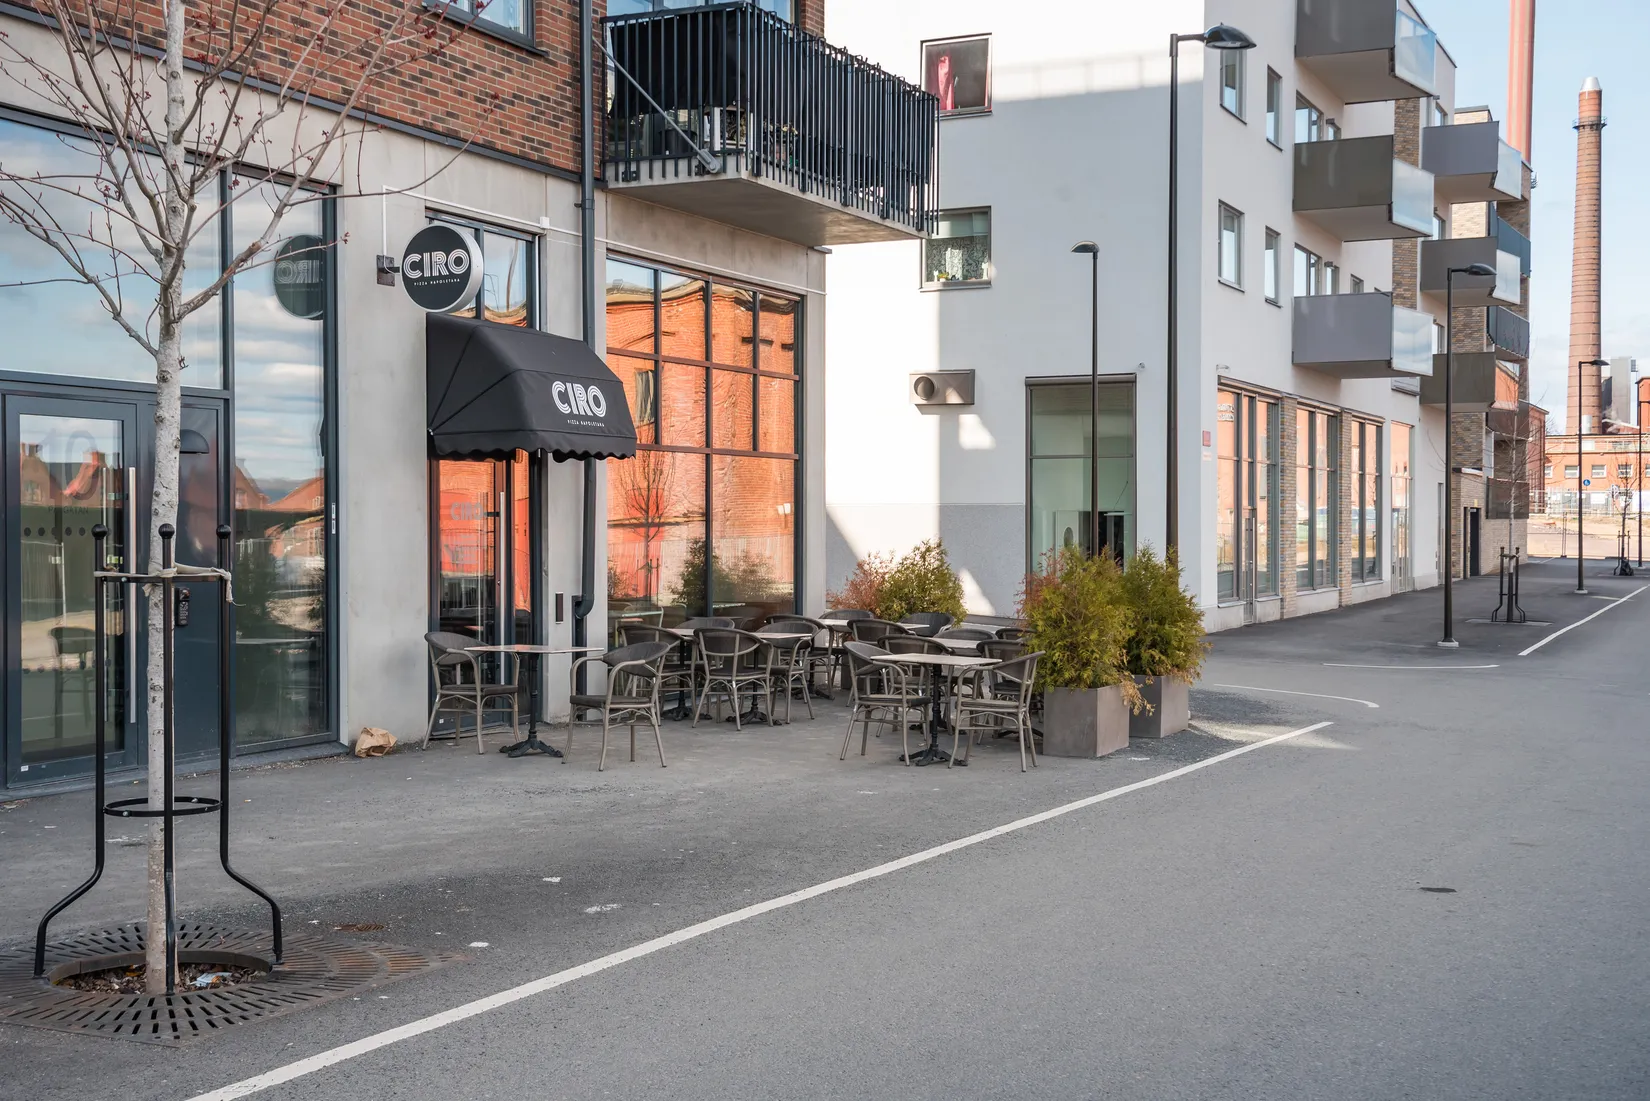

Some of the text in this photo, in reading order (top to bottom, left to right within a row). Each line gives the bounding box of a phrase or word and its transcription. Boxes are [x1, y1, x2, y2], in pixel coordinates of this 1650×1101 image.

[403, 248, 470, 279] CIRO
[551, 380, 607, 418] CIRO
[39, 427, 99, 501] 10
[451, 502, 484, 521] CIRO
